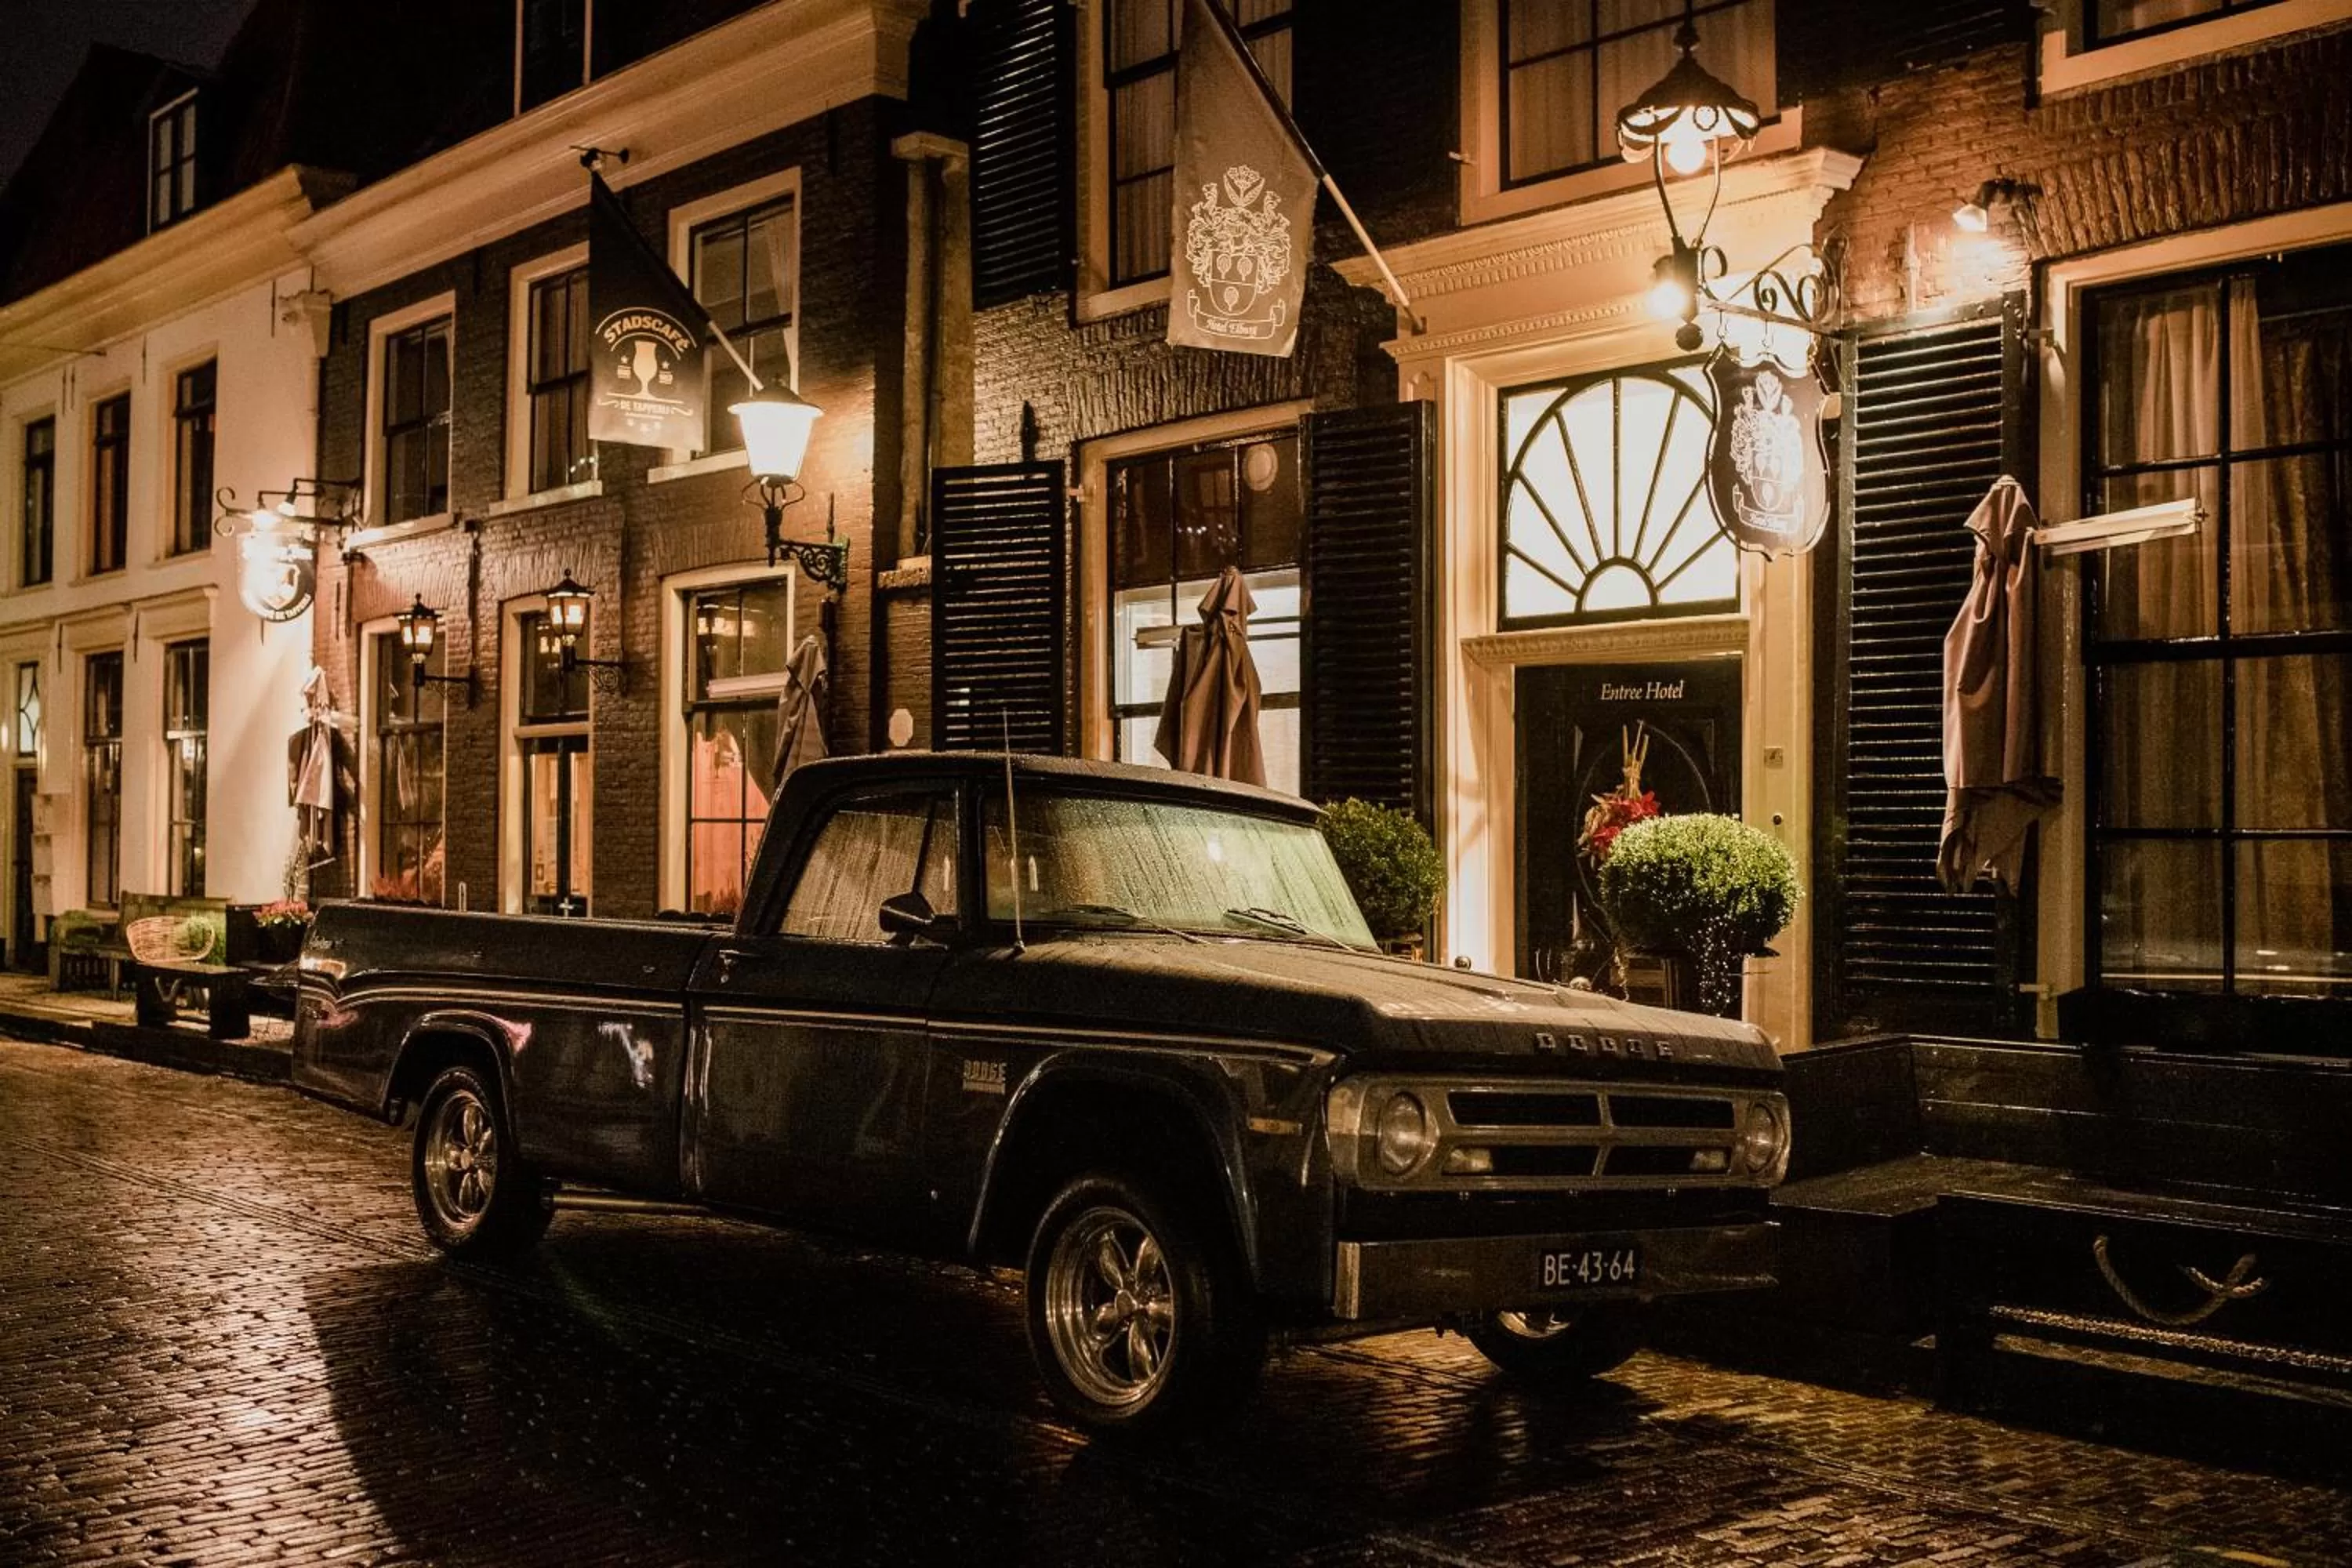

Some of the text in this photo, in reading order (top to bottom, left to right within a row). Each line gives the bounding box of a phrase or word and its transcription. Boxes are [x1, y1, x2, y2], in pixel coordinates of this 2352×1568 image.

[1600, 679, 1685, 700] Entree Hotel
[1535, 1032, 1674, 1056] DODGE
